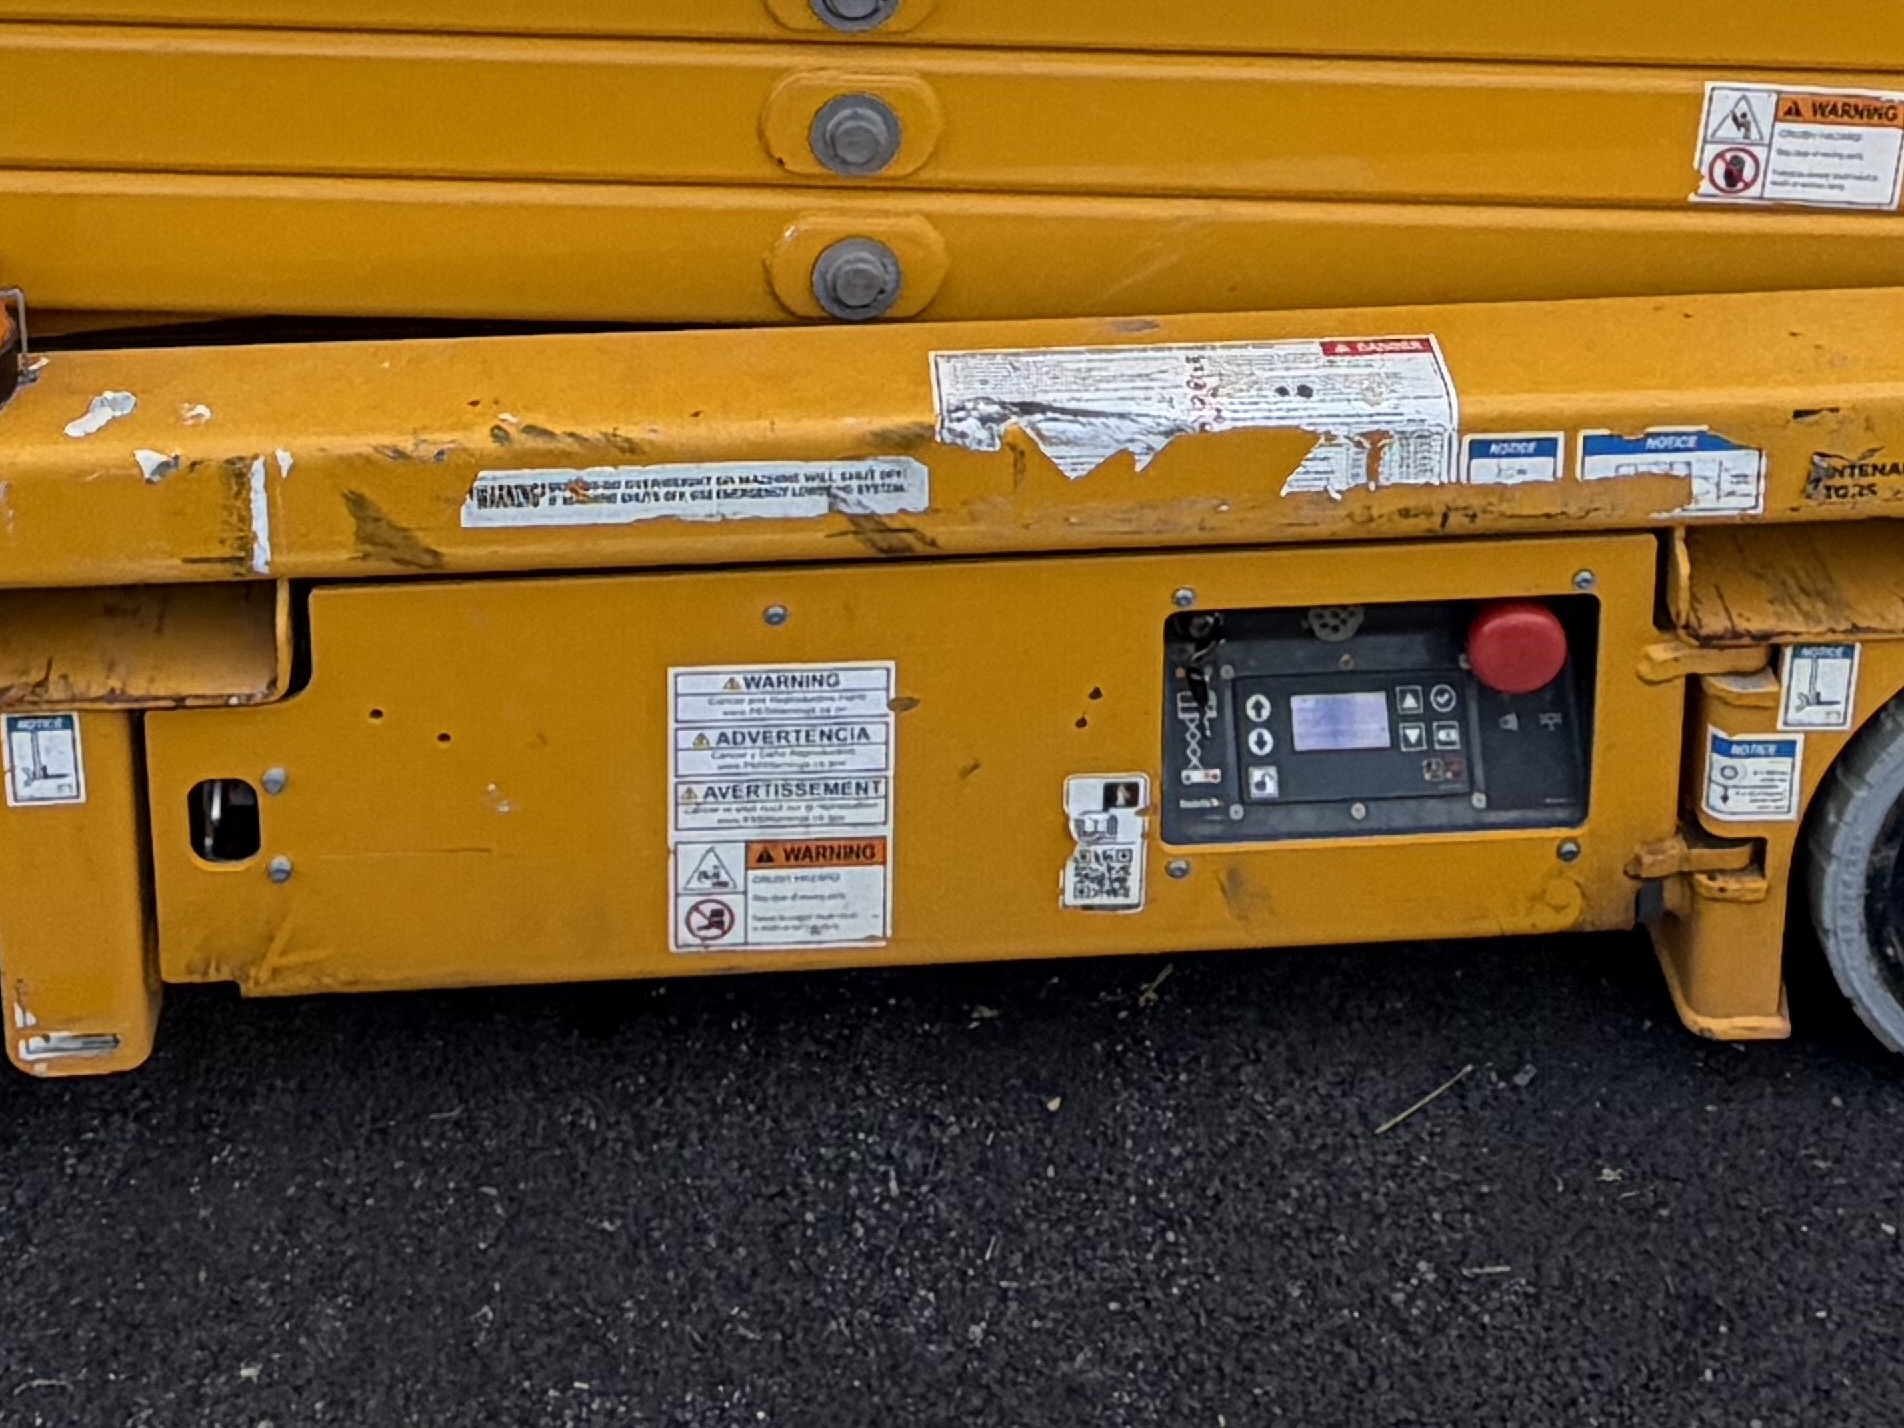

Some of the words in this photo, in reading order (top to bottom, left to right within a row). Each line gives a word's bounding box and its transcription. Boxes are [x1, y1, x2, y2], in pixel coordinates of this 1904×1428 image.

[1811, 101, 1898, 122] WARNING
[1489, 441, 1537, 455] NOTICE
[1645, 435, 1698, 450] NOTICE
[743, 672, 840, 691] WARNING
[716, 727, 871, 747] ADVERTENCIA
[703, 780, 882, 801] AVERTISSEMENT
[783, 843, 876, 863] WARNING
